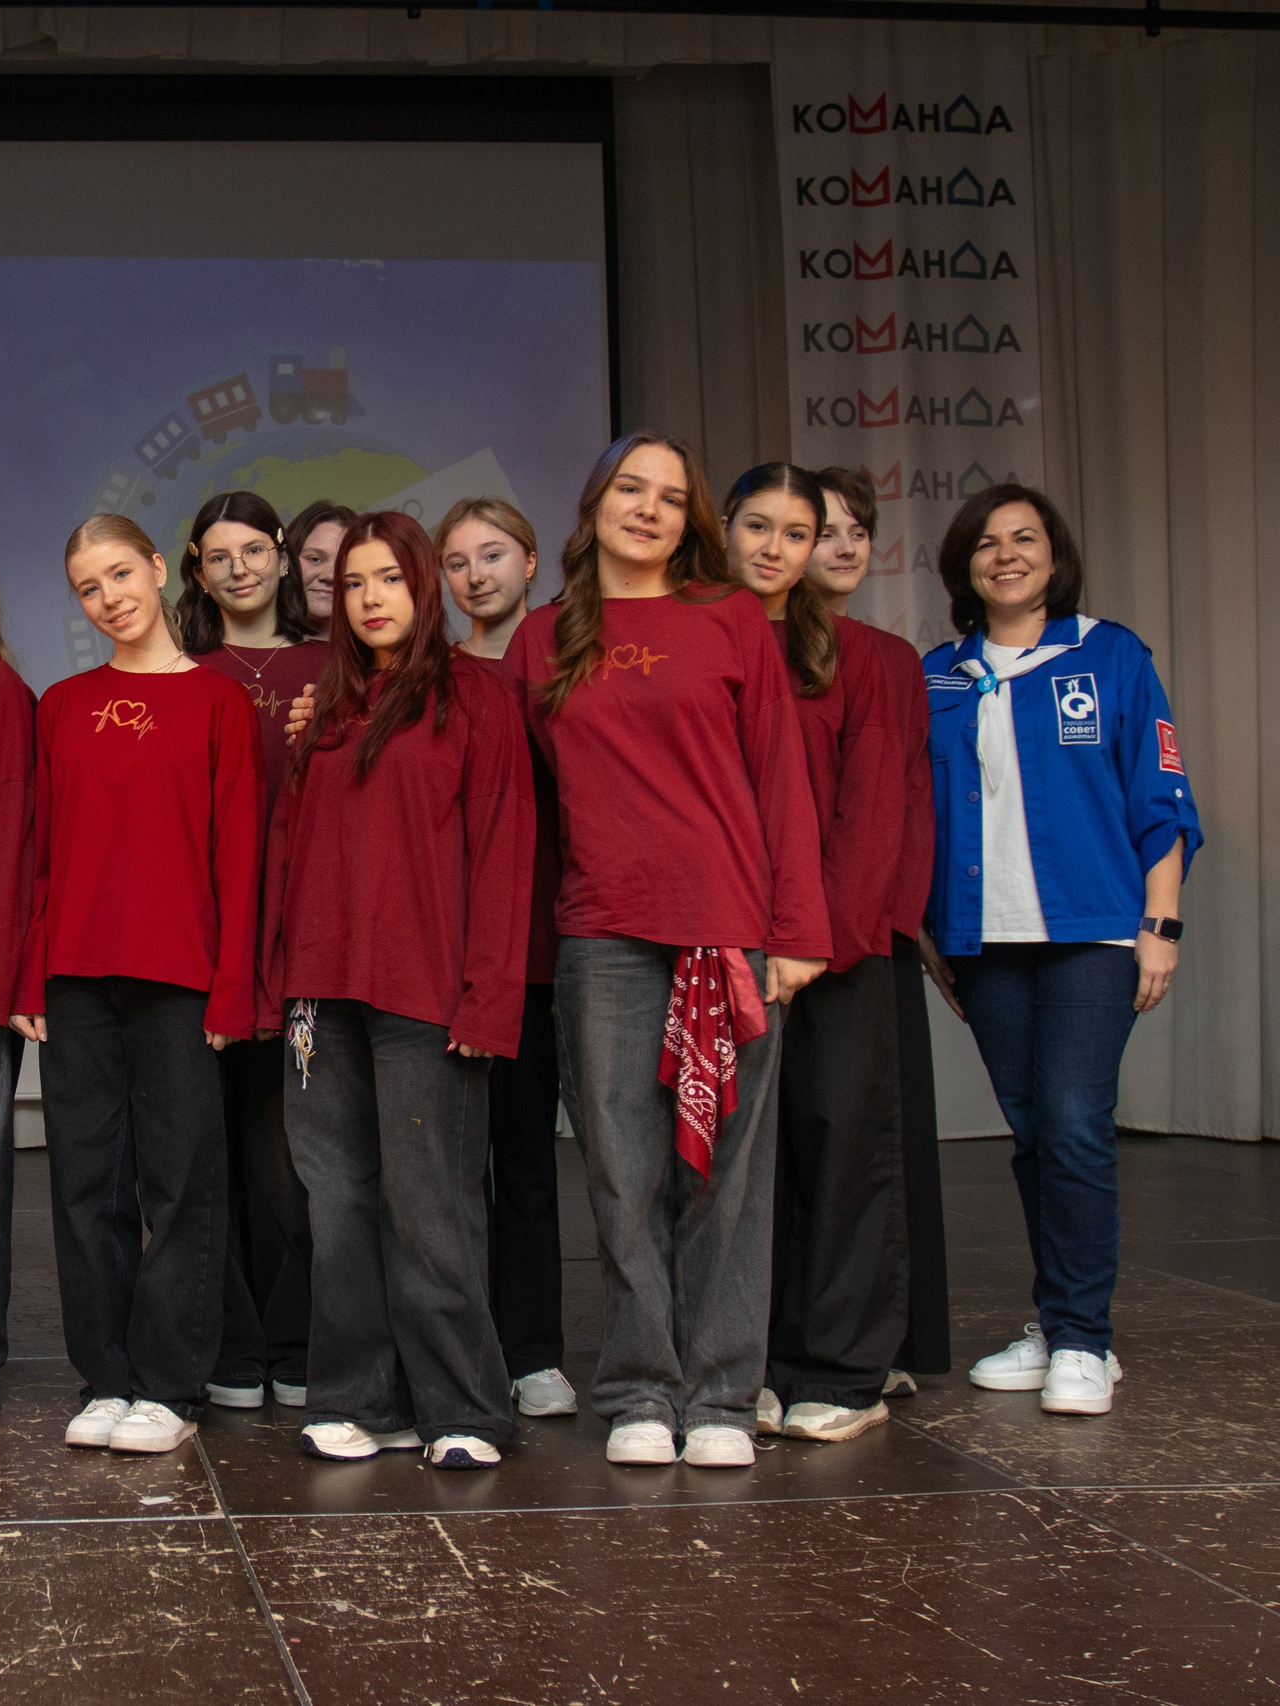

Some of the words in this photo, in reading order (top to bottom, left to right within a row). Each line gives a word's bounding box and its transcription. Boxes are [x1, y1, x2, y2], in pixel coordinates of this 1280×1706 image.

[793, 92, 1013, 134] КОМАНДА
[796, 165, 1016, 207] КОМАНДА
[800, 238, 1019, 280] КОМАНДА
[803, 311, 1022, 354] КОМАНДА
[806, 385, 1025, 428] КОМАНДА
